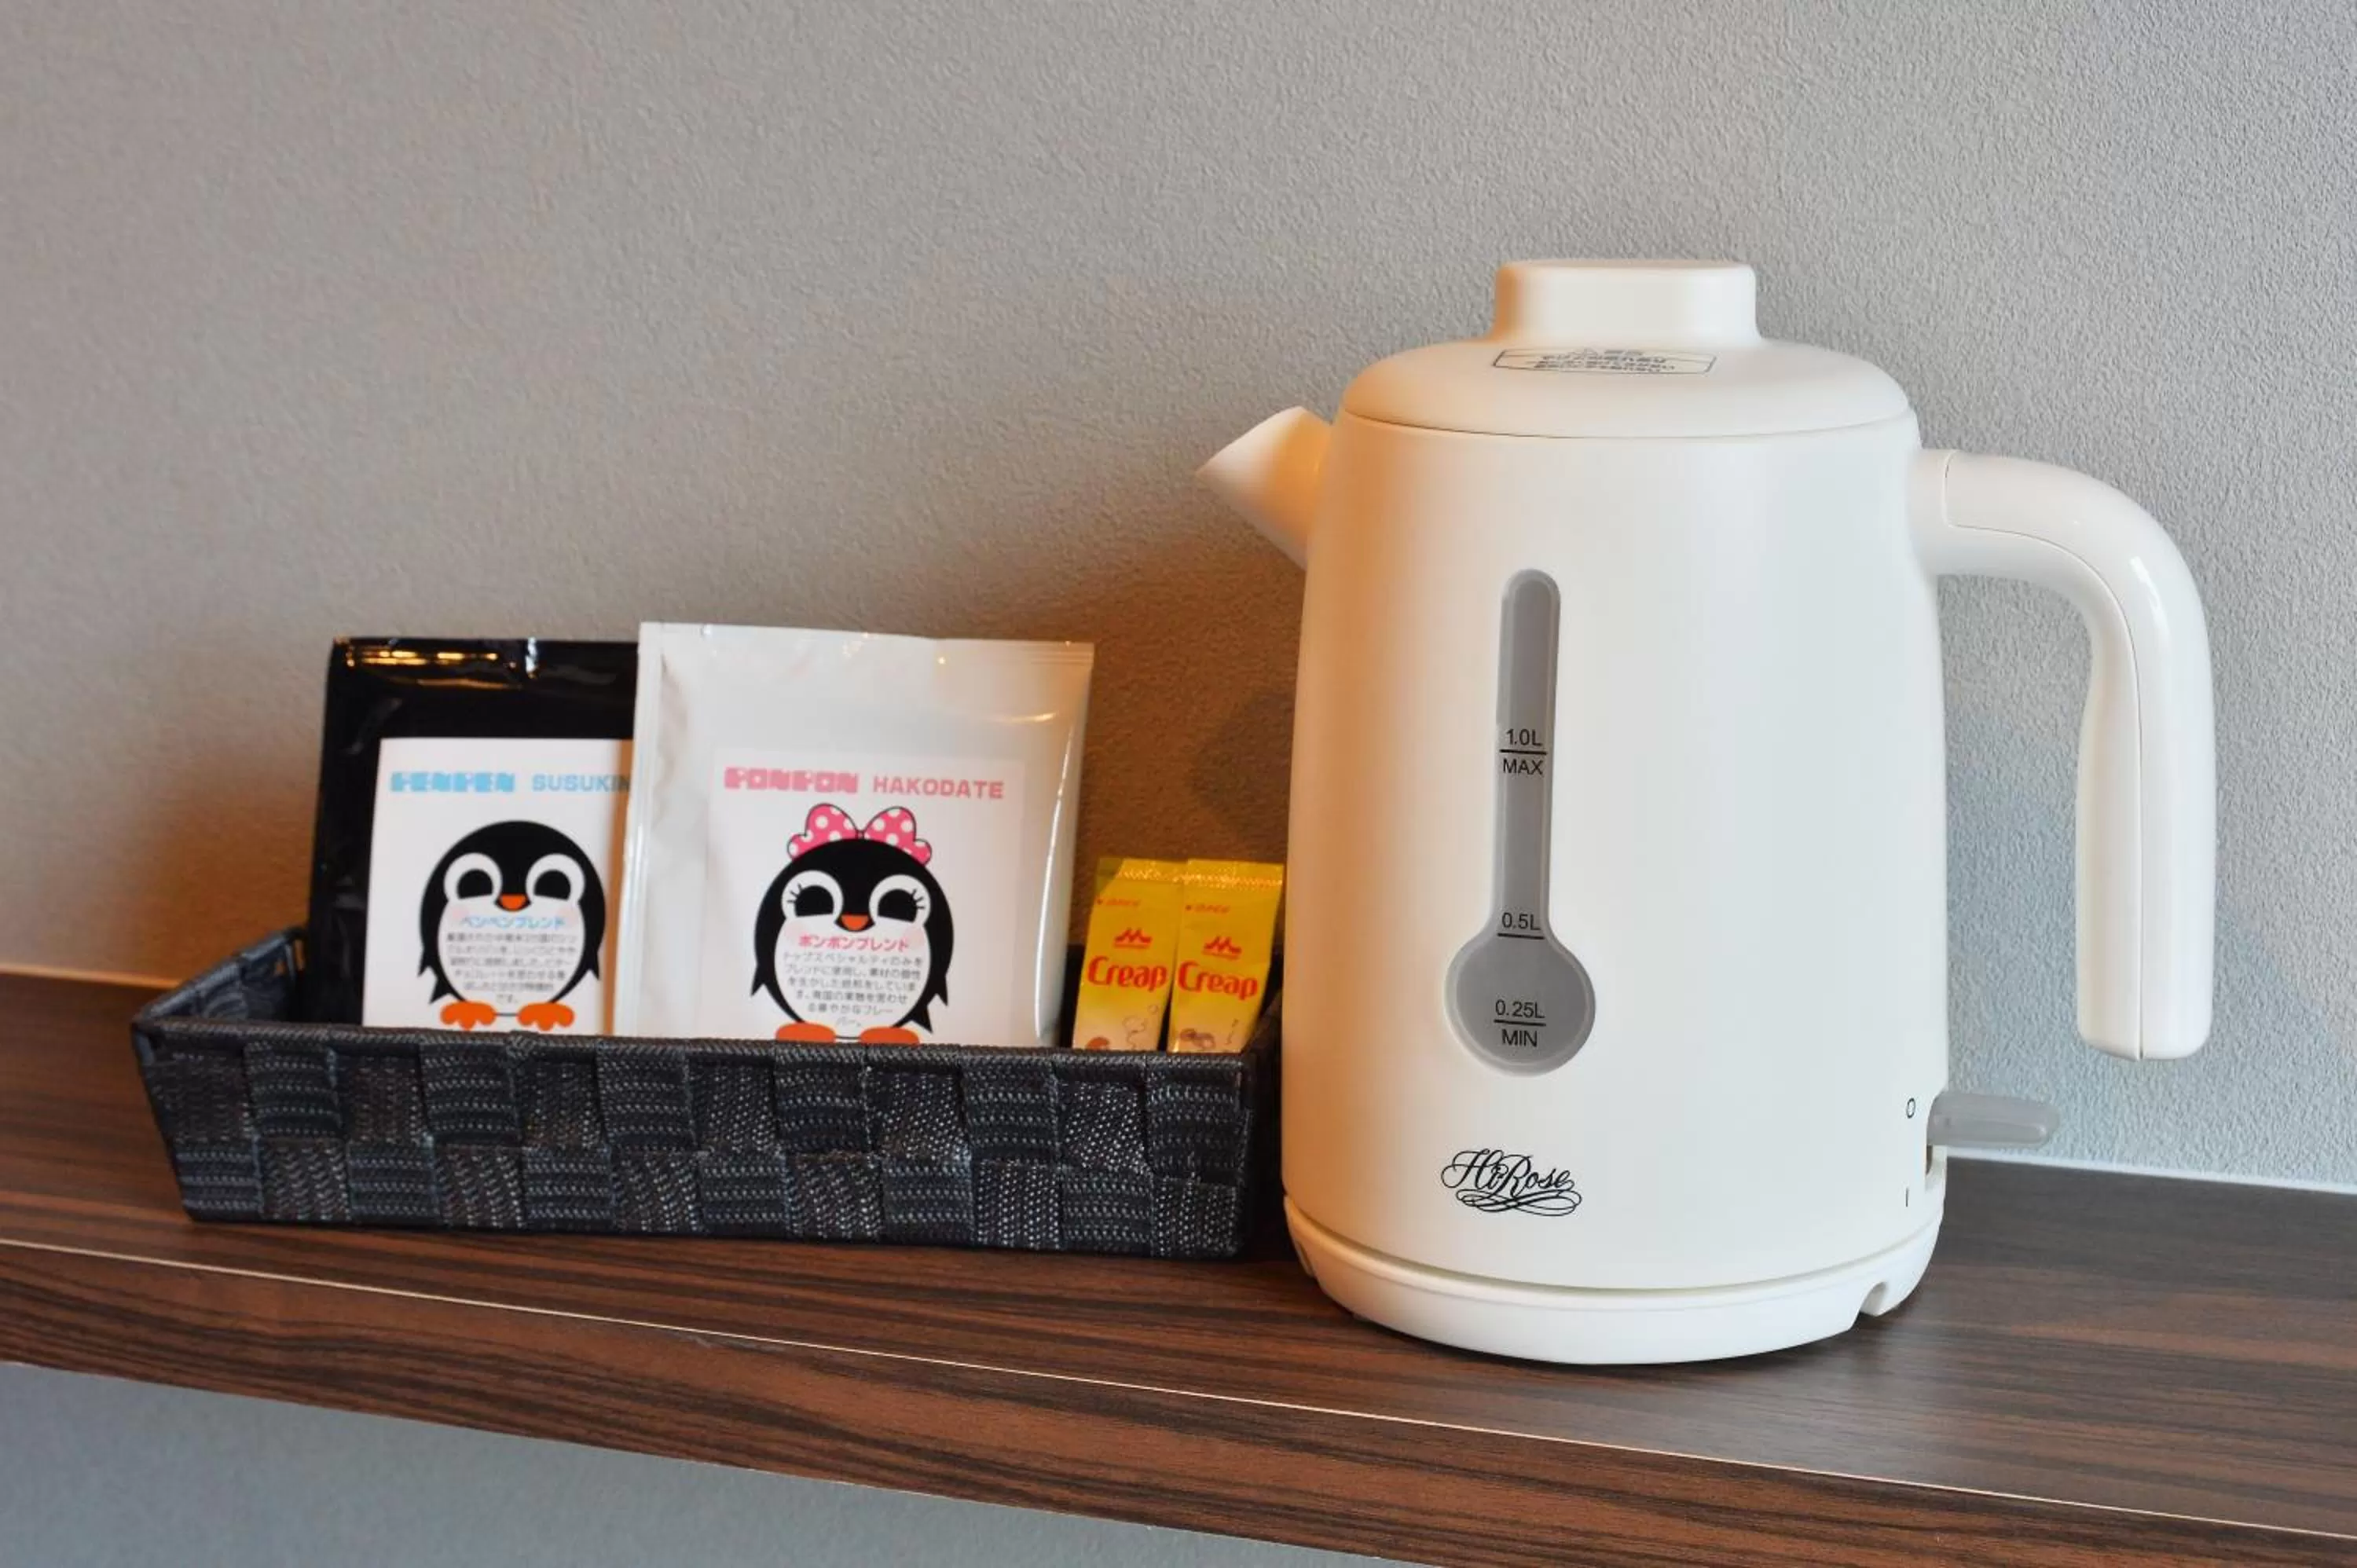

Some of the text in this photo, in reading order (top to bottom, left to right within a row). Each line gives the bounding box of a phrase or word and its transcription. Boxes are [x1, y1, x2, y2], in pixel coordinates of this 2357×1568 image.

[1506, 728, 1542, 746] 1.0L
[1503, 758, 1543, 775] MAX
[873, 775, 1005, 799] HAKODATE
[1502, 912, 1541, 930] 0.5L
[1087, 955, 1167, 991] Creap
[1178, 960, 1258, 1000] Creap
[1495, 999, 1545, 1018] 0.25L
[1502, 1028, 1538, 1047] MIN
